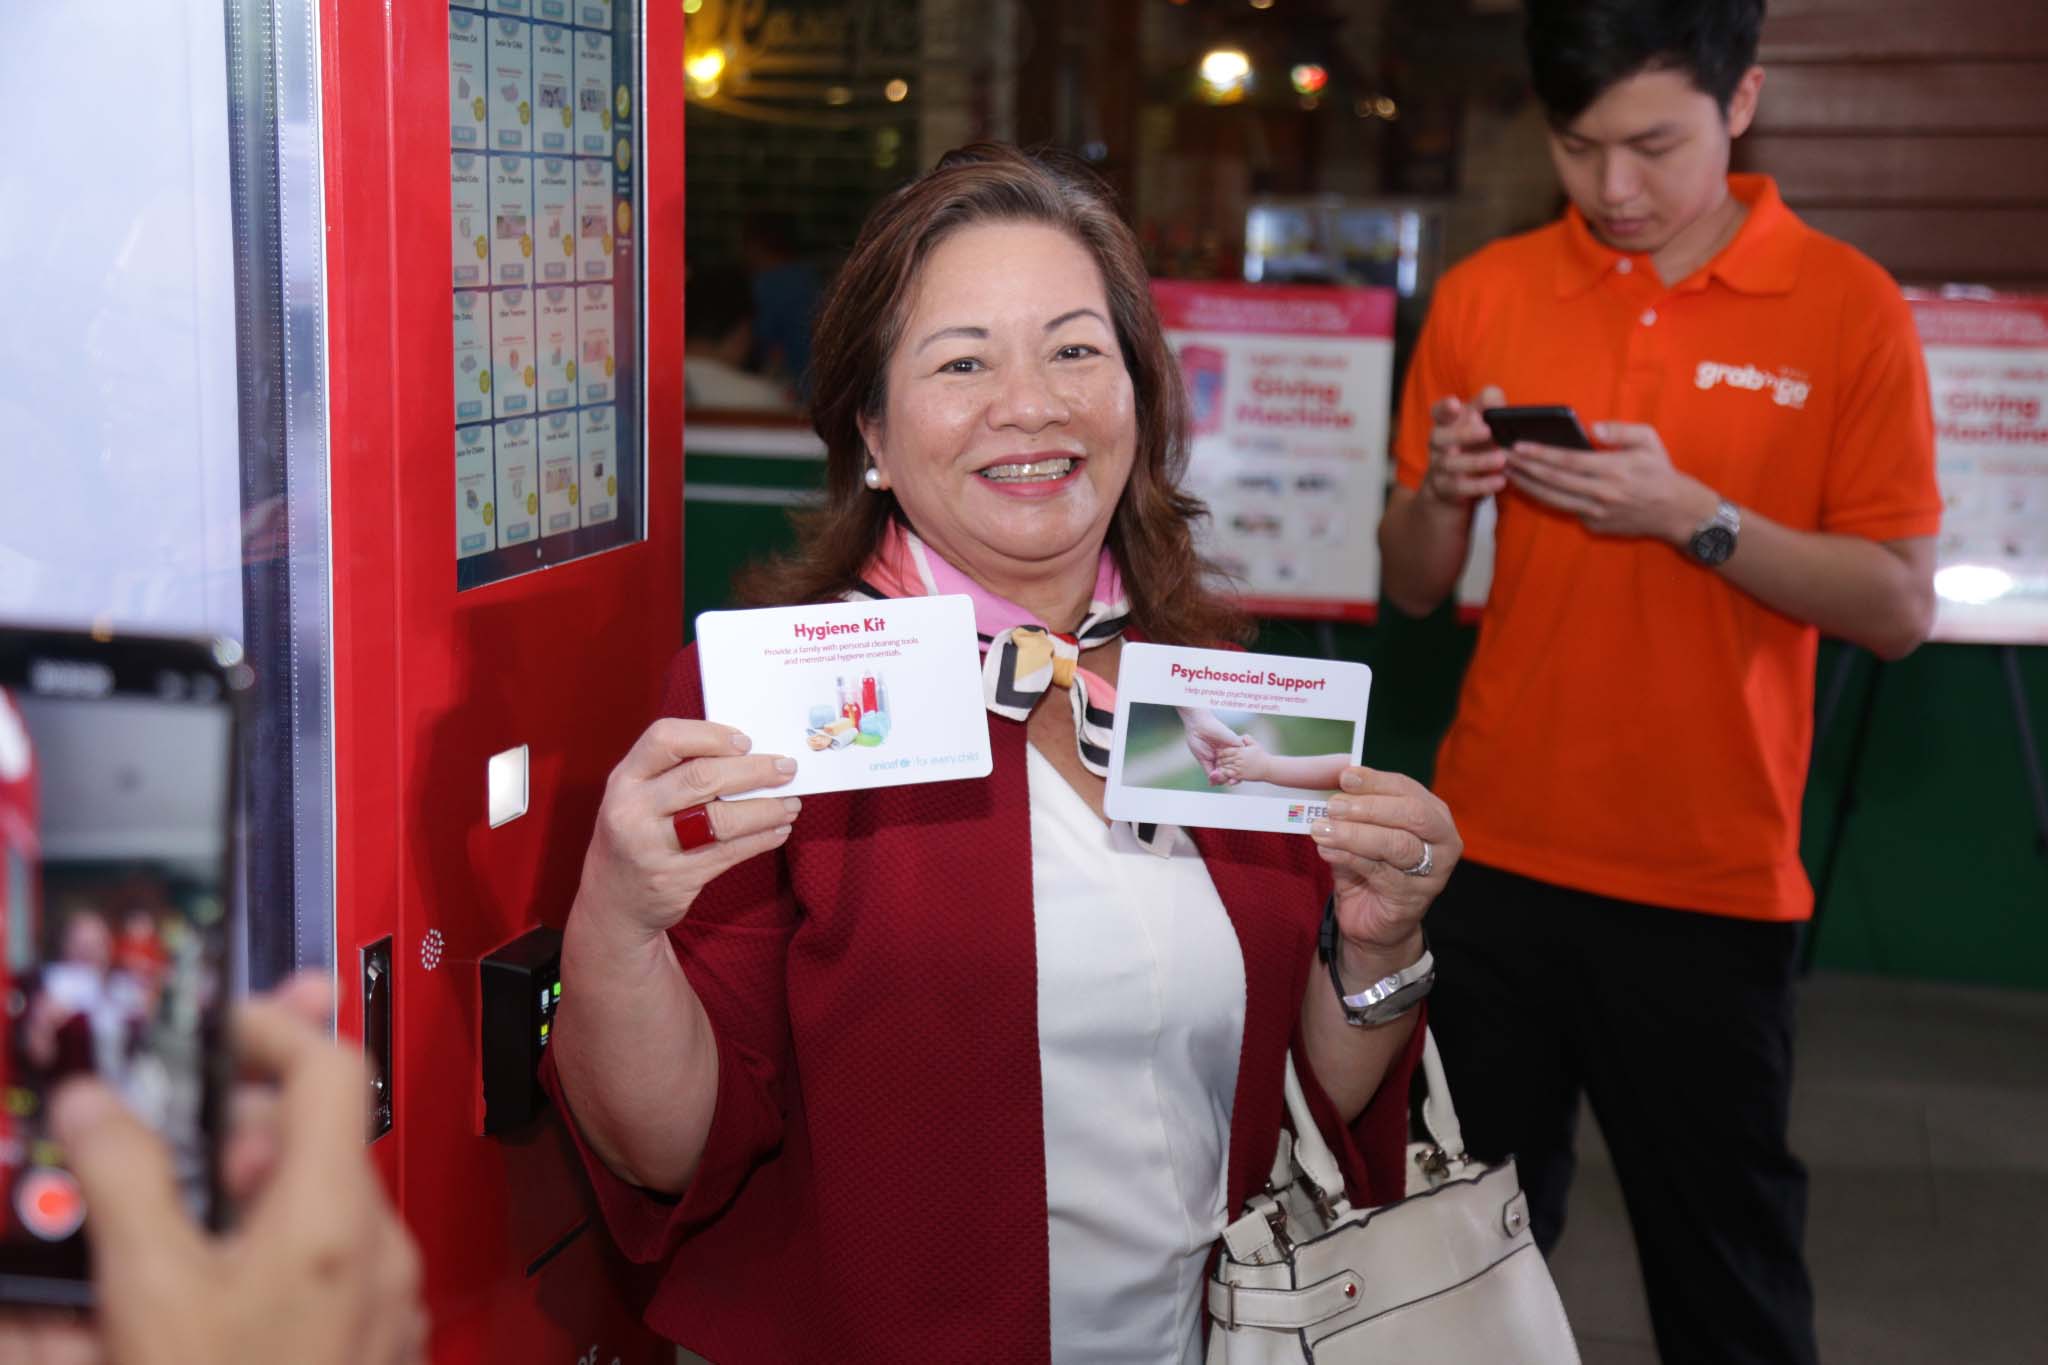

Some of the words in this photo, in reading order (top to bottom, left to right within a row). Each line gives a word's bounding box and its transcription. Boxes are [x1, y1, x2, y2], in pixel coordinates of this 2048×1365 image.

[794, 620, 860, 641] Hygiene
[863, 617, 886, 632] Kit
[763, 647, 792, 656] Provide
[799, 645, 821, 655] family
[822, 643, 838, 652] with
[839, 641, 870, 652] personal
[871, 639, 900, 648] cleaning
[783, 657, 798, 665] and
[799, 653, 836, 664] menstrual
[837, 652, 865, 663] hygiene
[1171, 663, 1264, 685] Psychosocial
[1267, 672, 1326, 692] Support
[1184, 686, 1201, 696] Help
[1201, 687, 1226, 697] provide
[1220, 698, 1247, 708] children
[870, 758, 898, 771] unicef
